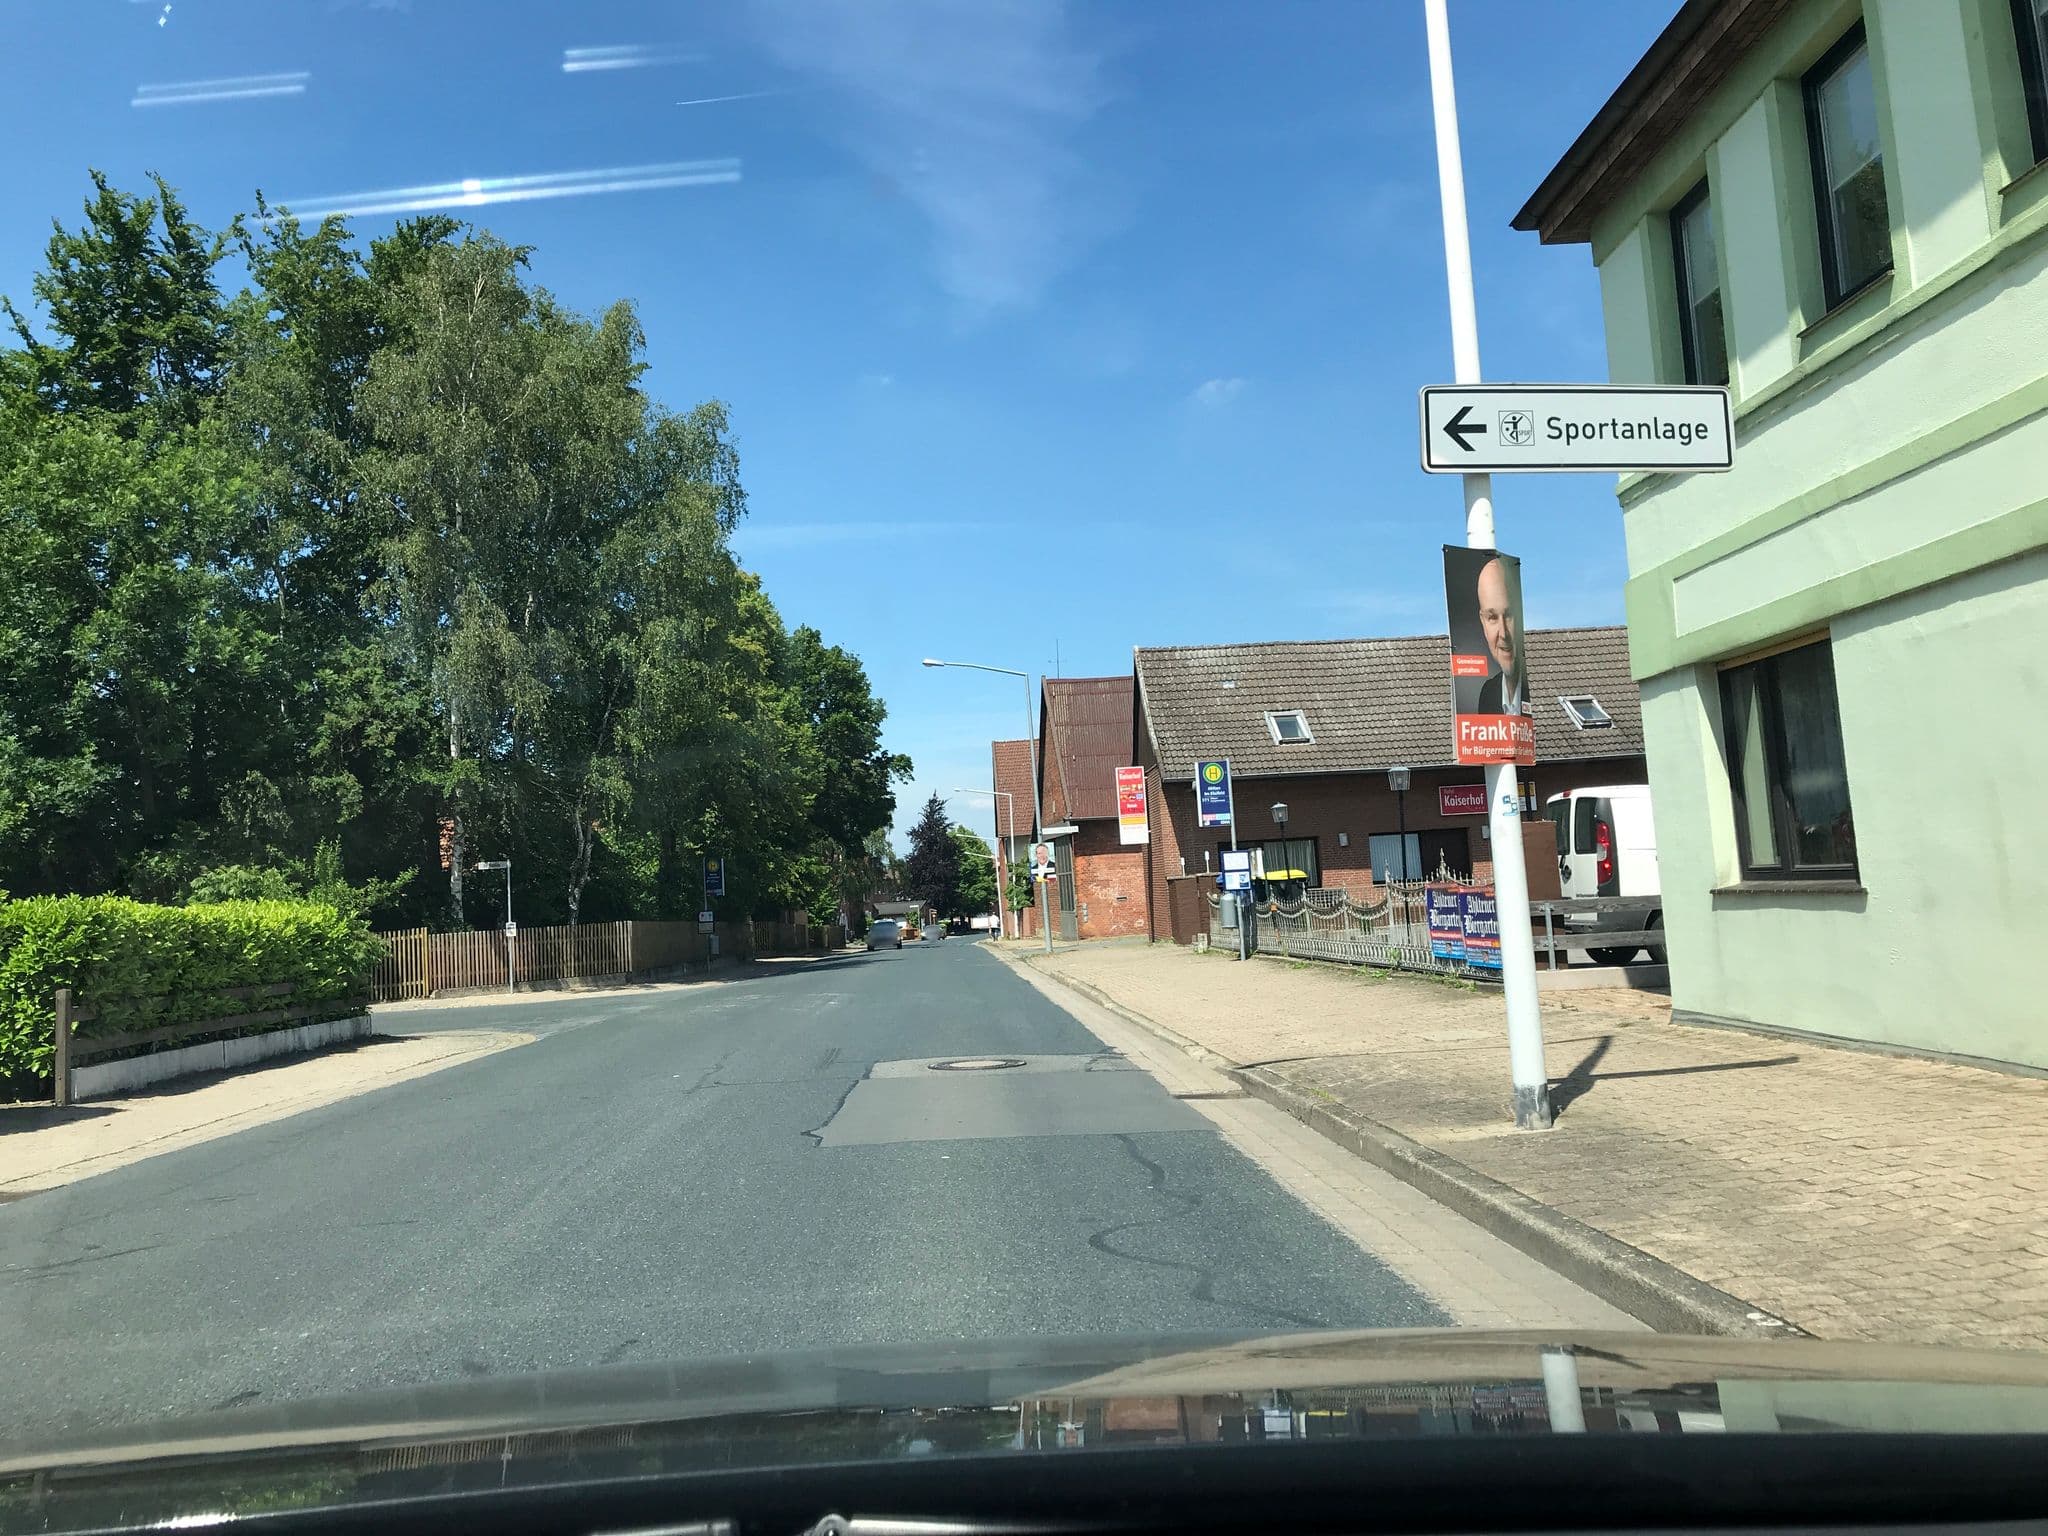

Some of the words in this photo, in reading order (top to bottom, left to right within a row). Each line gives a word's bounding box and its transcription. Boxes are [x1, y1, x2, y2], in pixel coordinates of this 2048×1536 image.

[1547, 416, 1709, 445] Sportanlage
[1461, 719, 1508, 741] Frank
[1462, 746, 1472, 755] Ihr
[1473, 746, 1519, 757] Bürgermeis
[1444, 793, 1485, 807] Kaiserhof
